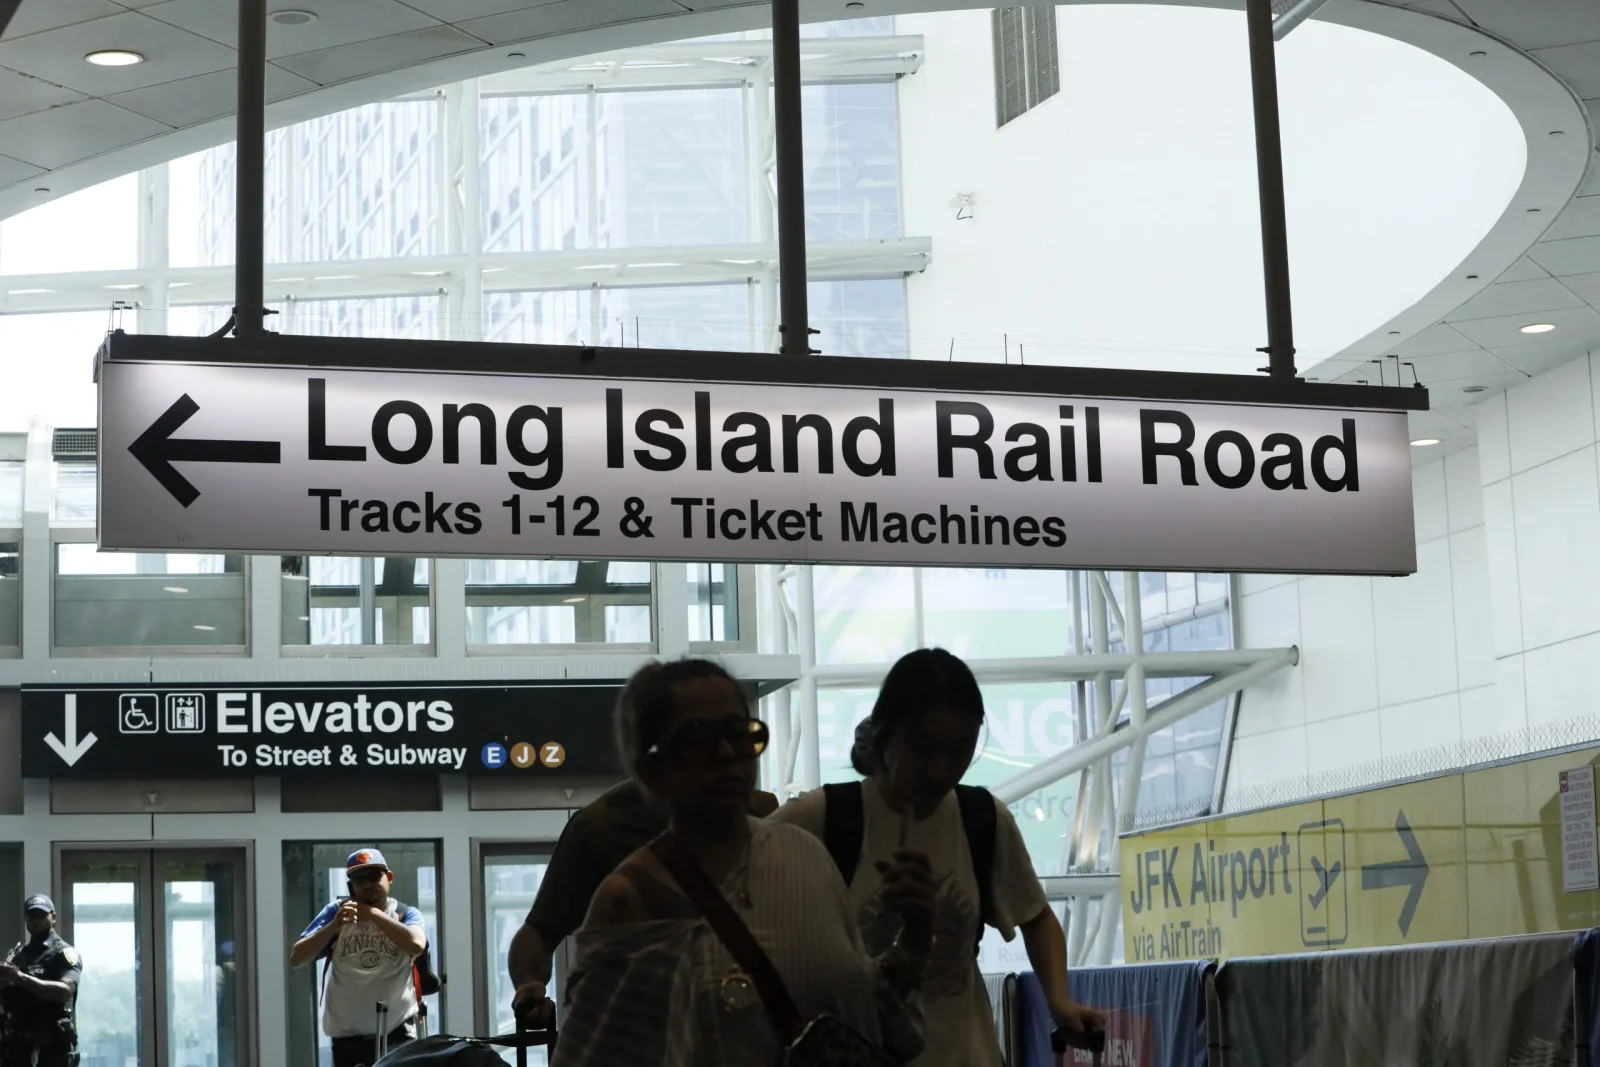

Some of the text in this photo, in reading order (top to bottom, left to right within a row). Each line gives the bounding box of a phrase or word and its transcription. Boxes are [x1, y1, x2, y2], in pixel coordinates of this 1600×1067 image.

[308, 377, 1360, 493] Long Island Rail Road
[307, 488, 1067, 548] Tracks 1-12 & Ticket Machines
[216, 692, 454, 734] Elevators
[217, 745, 248, 767] To
[255, 744, 332, 766] Street
[339, 744, 358, 766] &
[366, 743, 467, 770] Subway
[487, 746, 501, 764] E
[545, 745, 560, 763] Z
[1130, 831, 1293, 919] JFK Airport
[1133, 918, 1222, 962] via AirTrain
